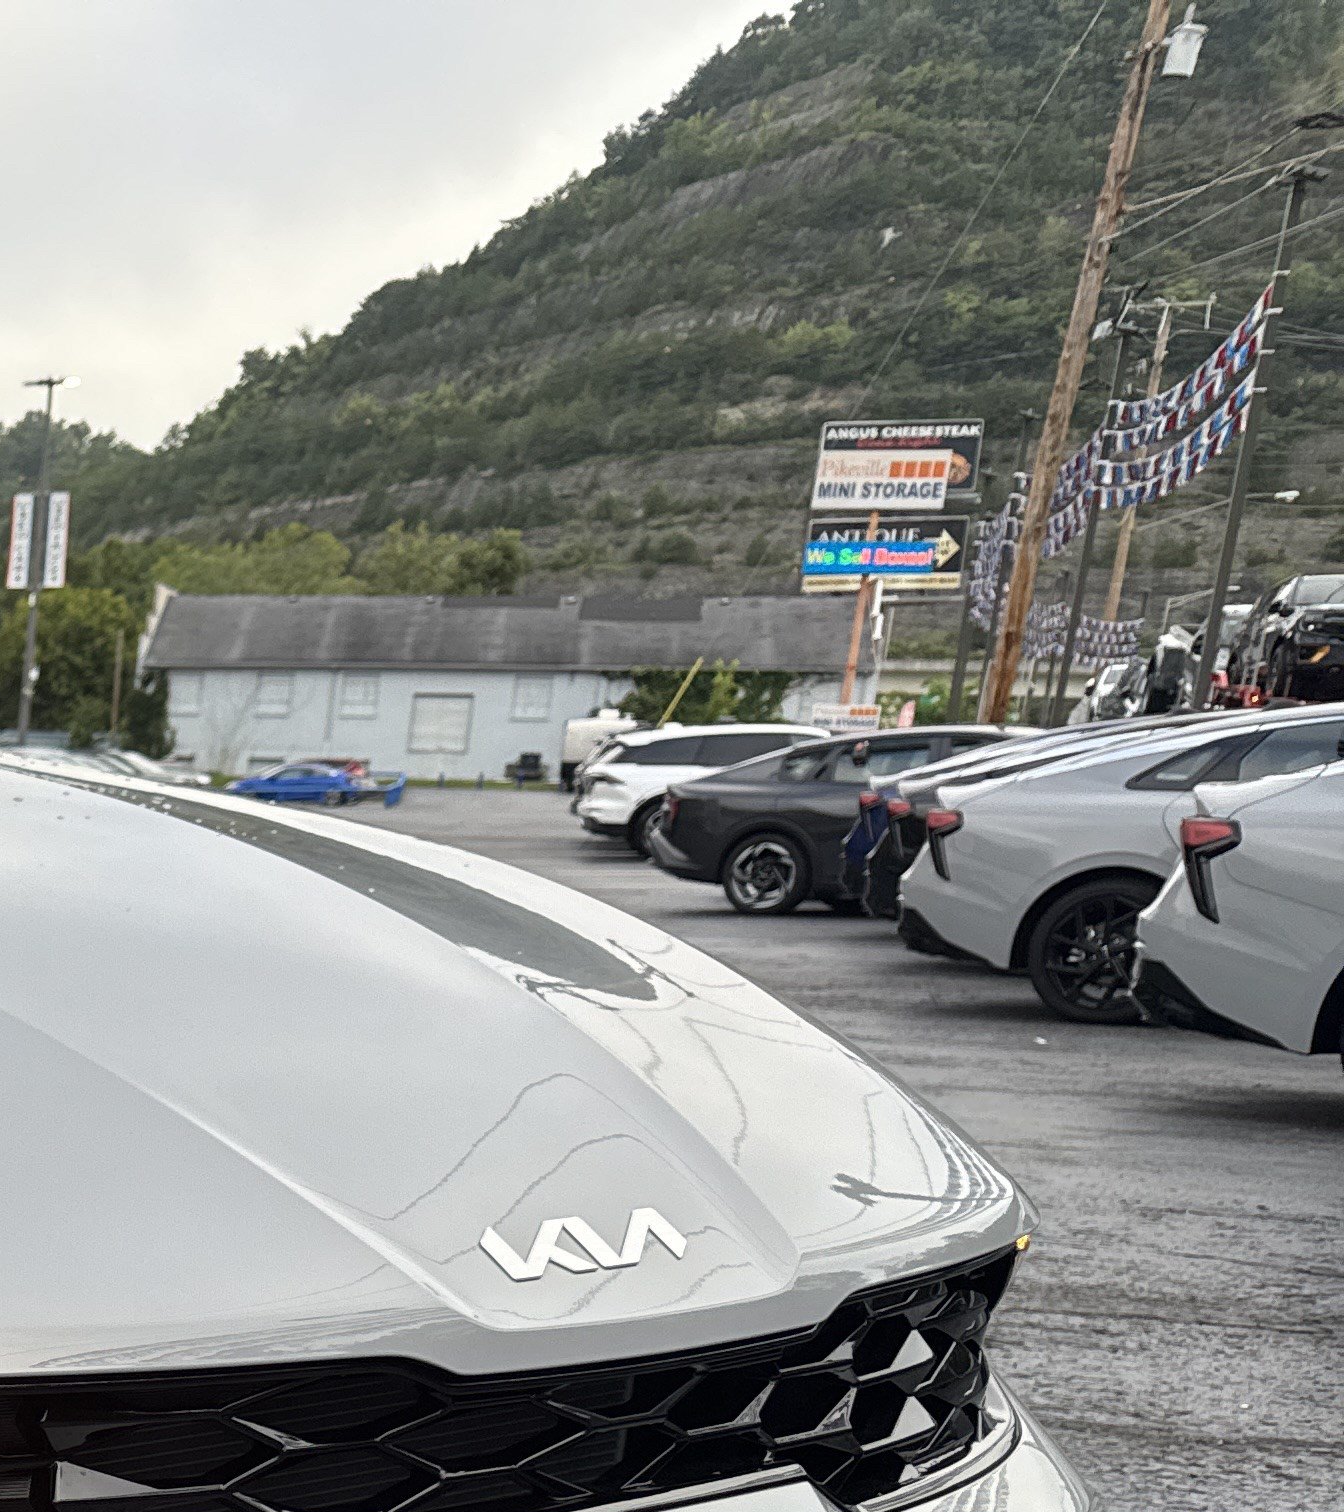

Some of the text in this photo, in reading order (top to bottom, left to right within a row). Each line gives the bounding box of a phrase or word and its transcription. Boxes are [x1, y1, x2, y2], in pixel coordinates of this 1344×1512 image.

[826, 426, 879, 440] ANGUS
[818, 481, 943, 499] MINI STORAGE
